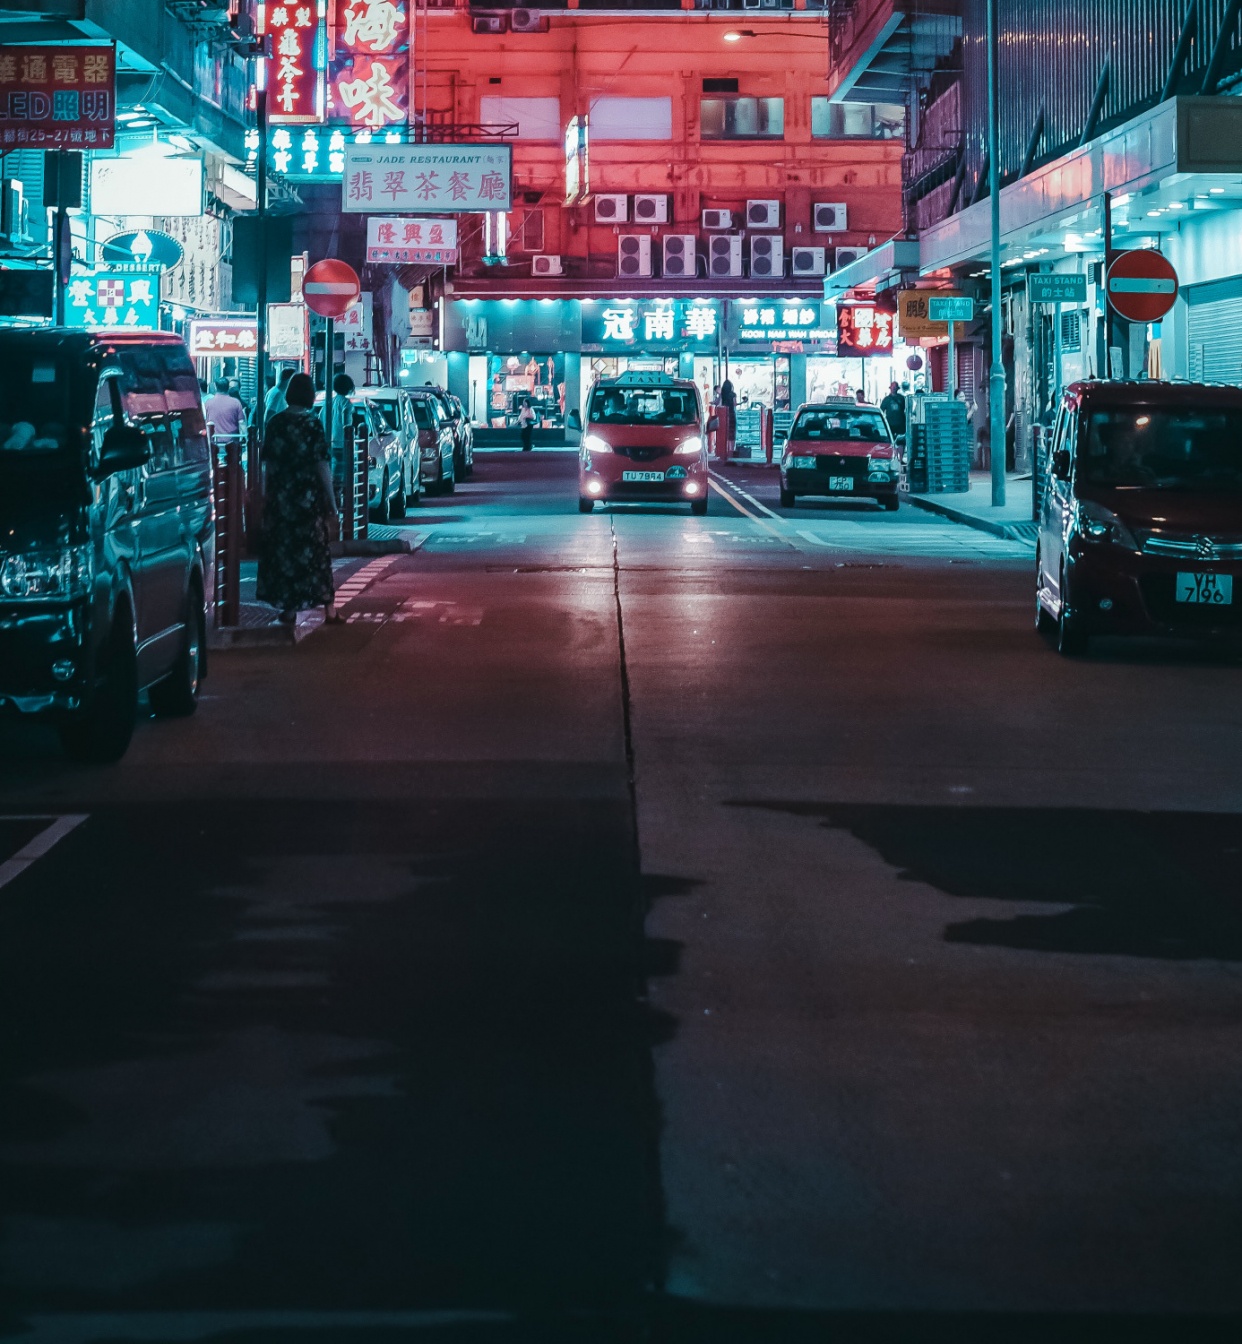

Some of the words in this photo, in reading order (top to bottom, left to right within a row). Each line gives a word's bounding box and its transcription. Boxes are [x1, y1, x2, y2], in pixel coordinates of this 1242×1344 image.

[376, 156, 405, 164] JADE
[409, 156, 482, 164] RESTAURANT
[348, 170, 507, 202] 翡翠茶餐廳
[115, 263, 166, 274] DESSERTS
[1033, 277, 1051, 285] TAXI
[1054, 277, 1083, 285] STAND
[1041, 287, 1075, 298] 的士站
[602, 307, 717, 340] 冠南華
[741, 330, 765, 339] KOON
[767, 330, 786, 339] NAM
[788, 330, 807, 339] WAH
[625, 472, 637, 480] TU
[1193, 573, 1217, 589] YH
